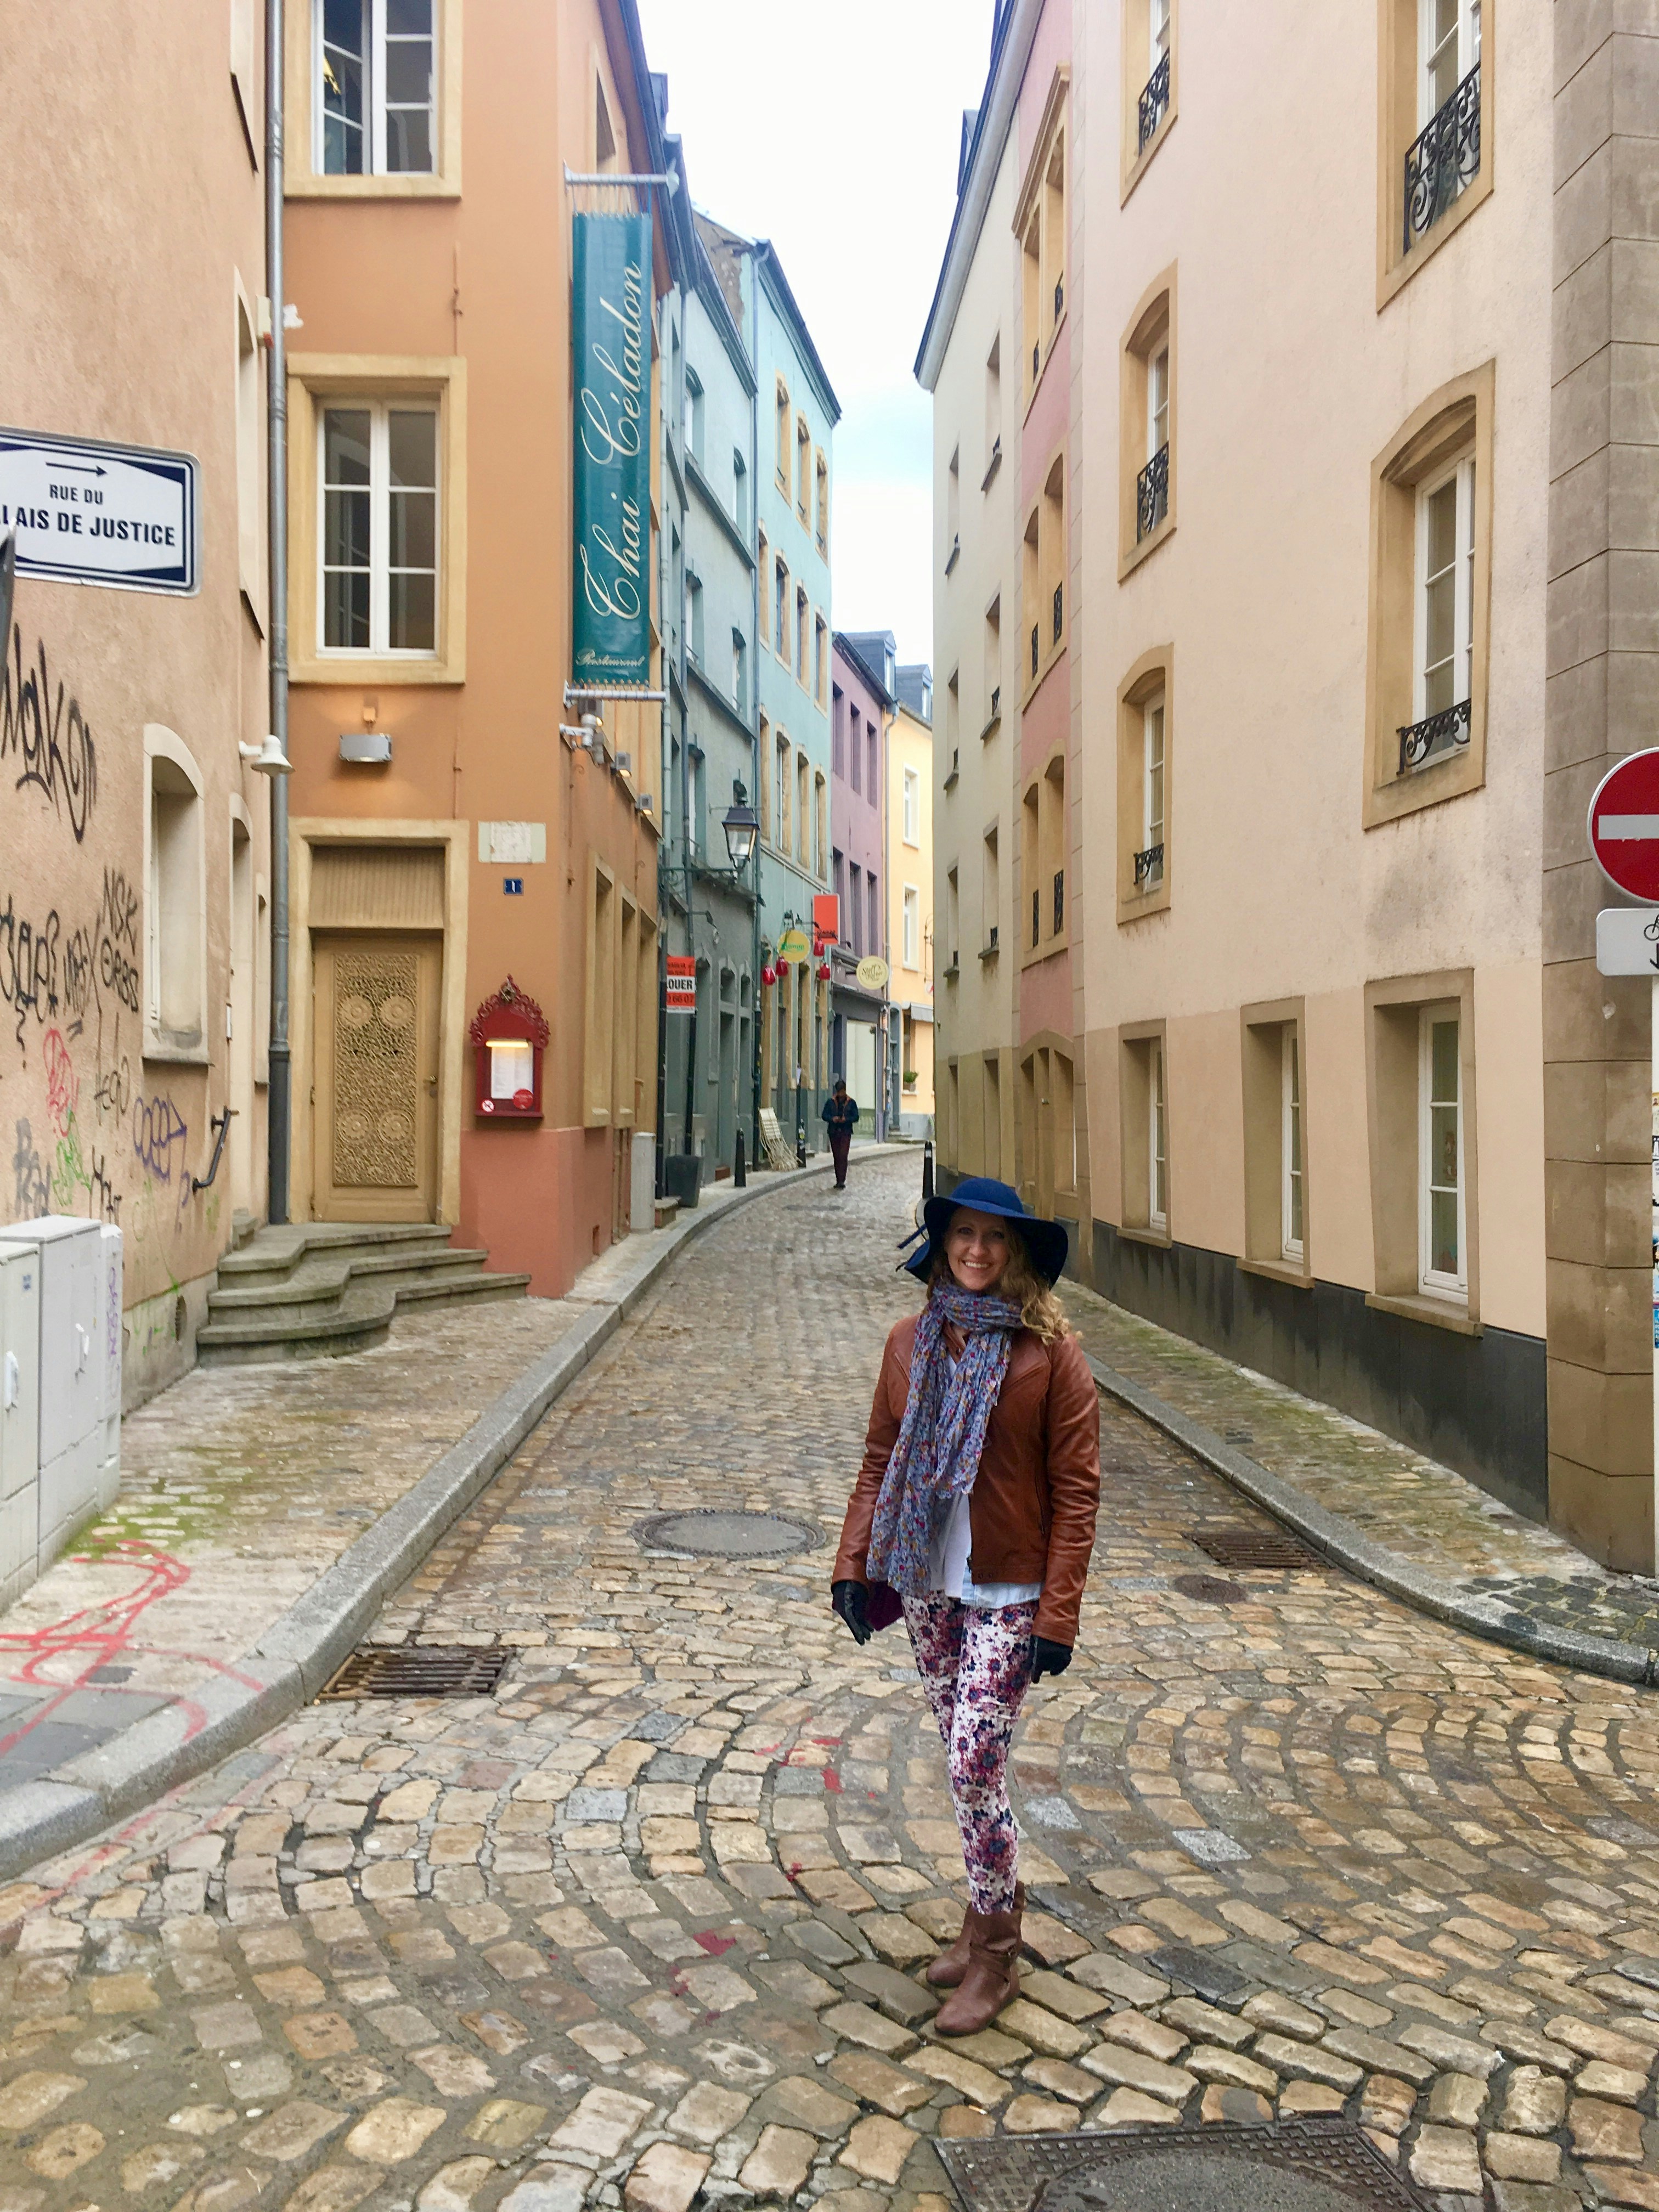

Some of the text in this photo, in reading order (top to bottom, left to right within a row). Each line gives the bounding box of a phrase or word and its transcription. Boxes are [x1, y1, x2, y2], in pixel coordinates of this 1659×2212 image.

[49, 484, 104, 505] RUE DU
[0, 504, 176, 547] LAIS DE JUSTICE
[667, 978, 693, 990] OUER
